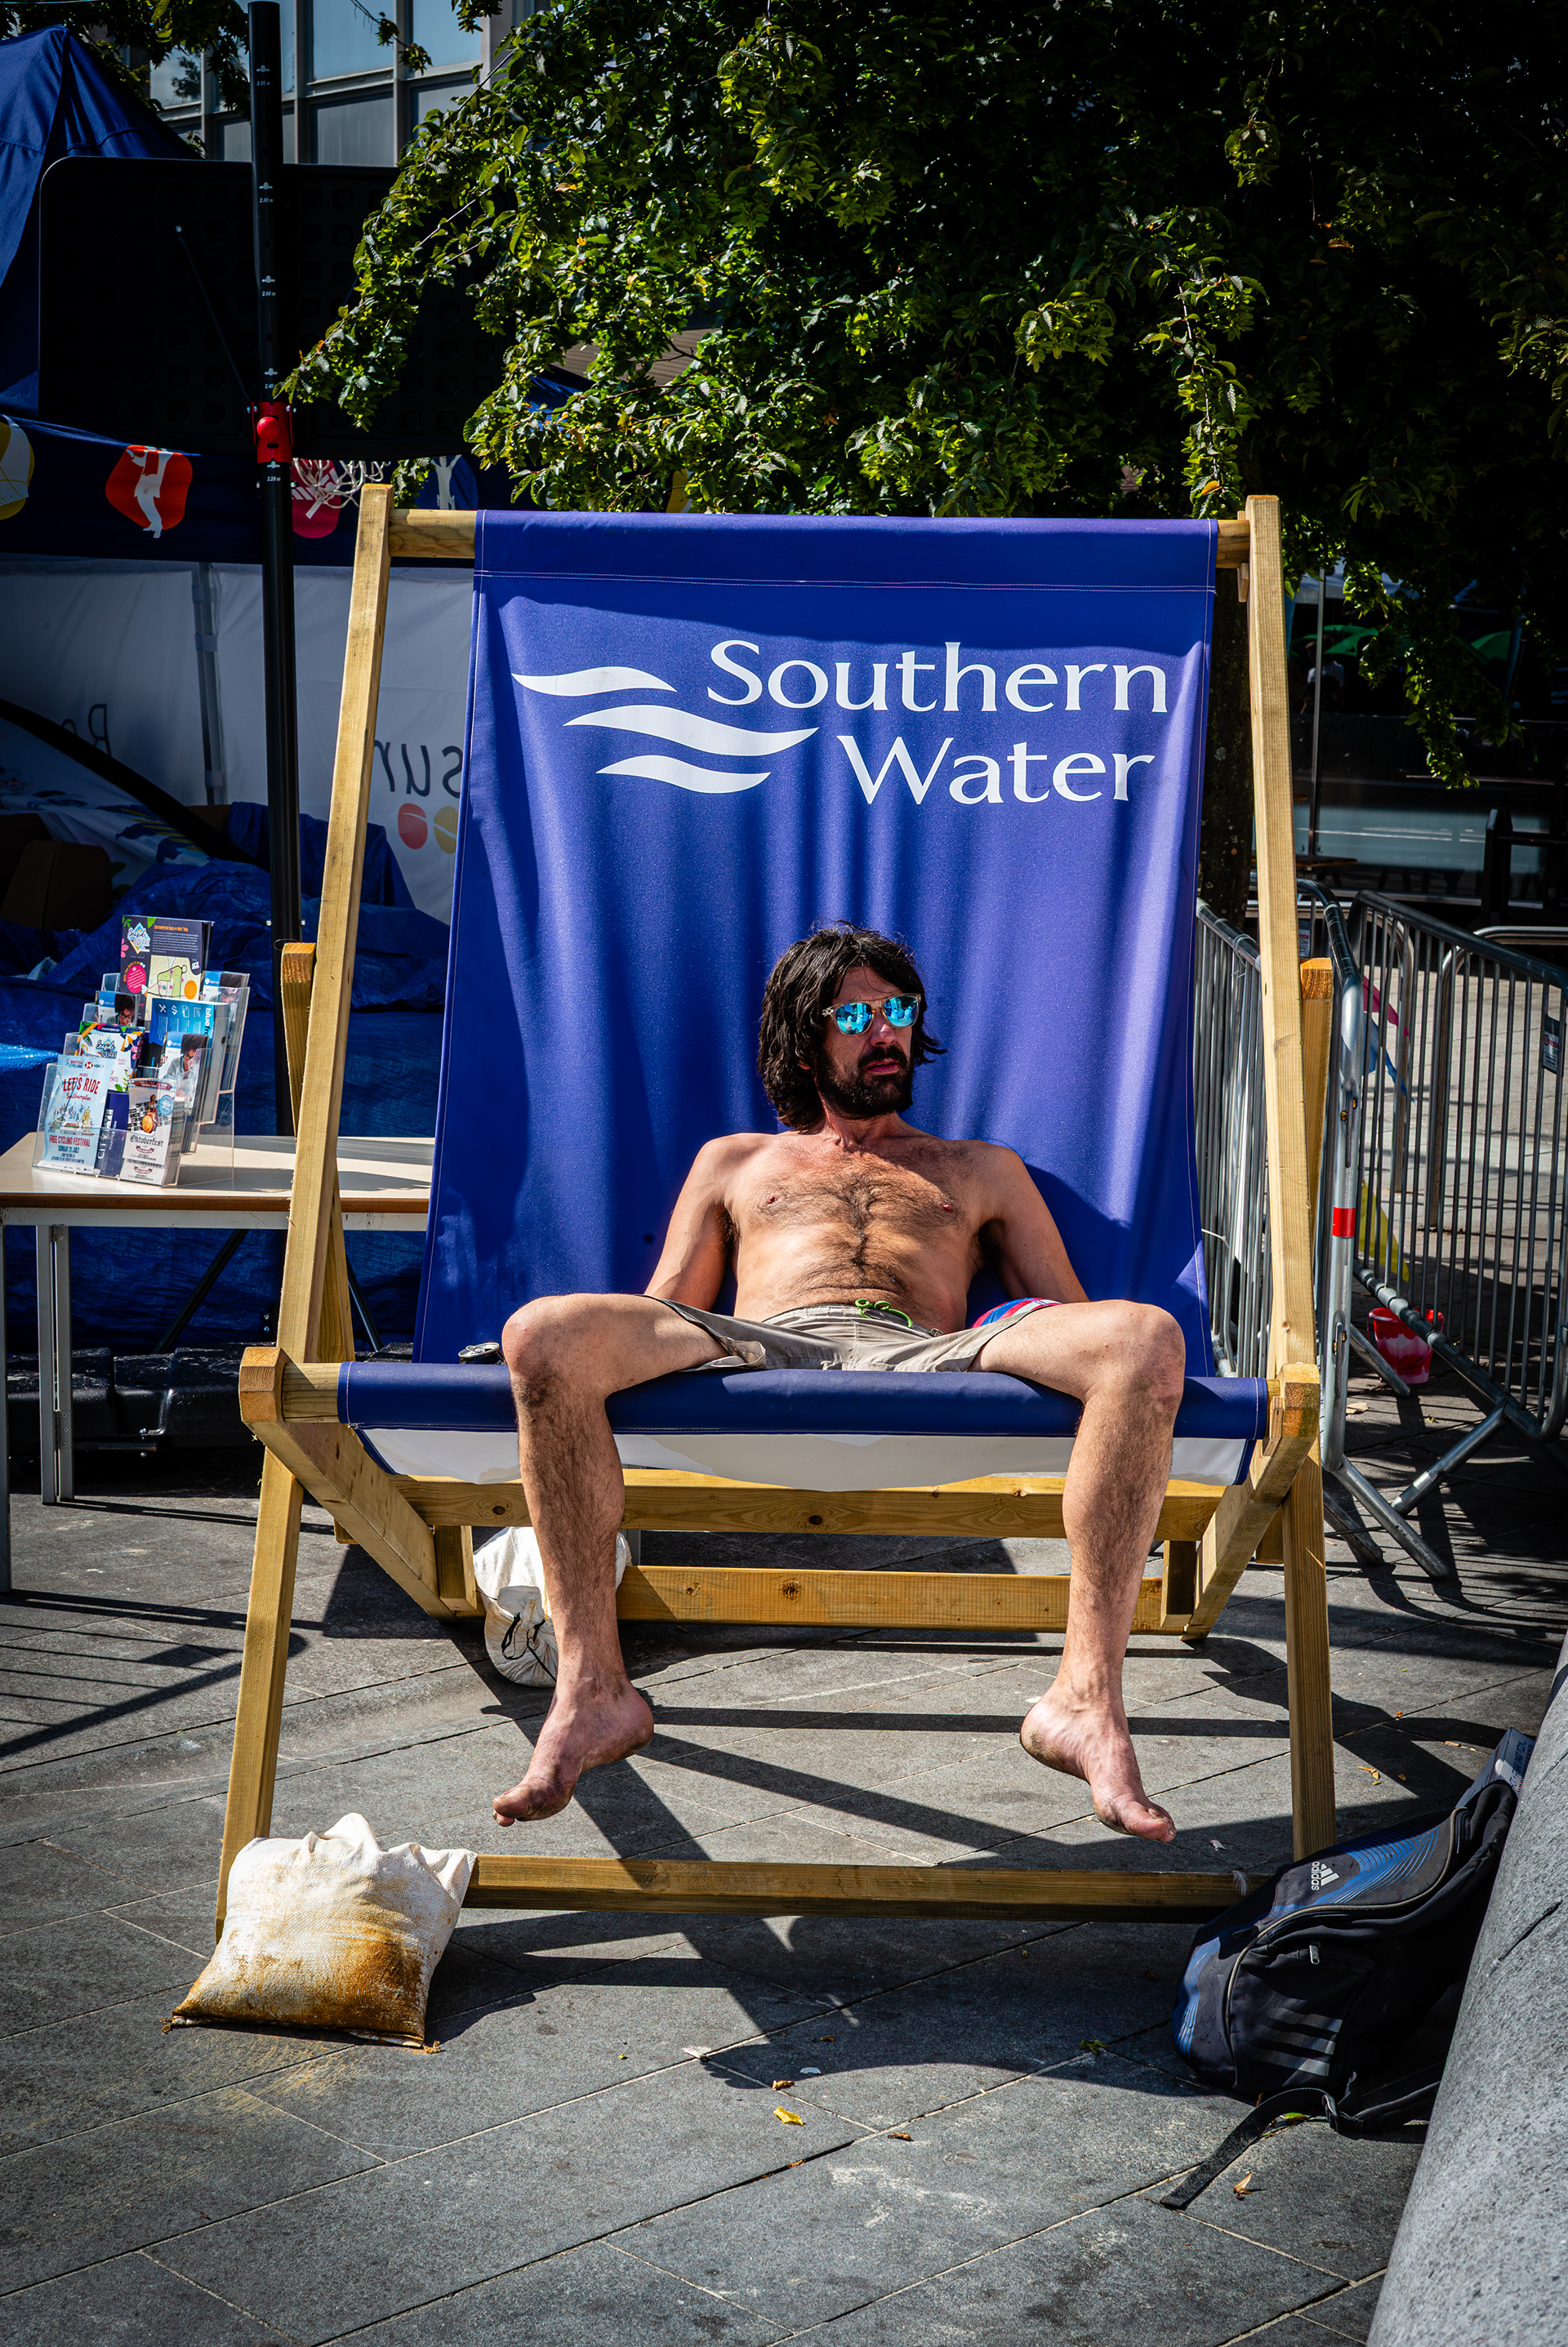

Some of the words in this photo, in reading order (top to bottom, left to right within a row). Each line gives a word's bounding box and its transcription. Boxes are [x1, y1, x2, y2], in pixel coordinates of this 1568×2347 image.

[707, 639, 1169, 712] Southern
[836, 735, 1156, 804] Water
[63, 1077, 83, 1092] LET'S
[82, 1077, 101, 1094] RIDE
[66, 1093, 91, 1102] Southampton
[49, 1134, 58, 1144] FREE
[58, 1135, 74, 1145] CYCLING
[73, 1137, 91, 1147] FESTIVAL
[130, 1134, 164, 1147] Oktoberfest
[1311, 1861, 1321, 1891] adidas
